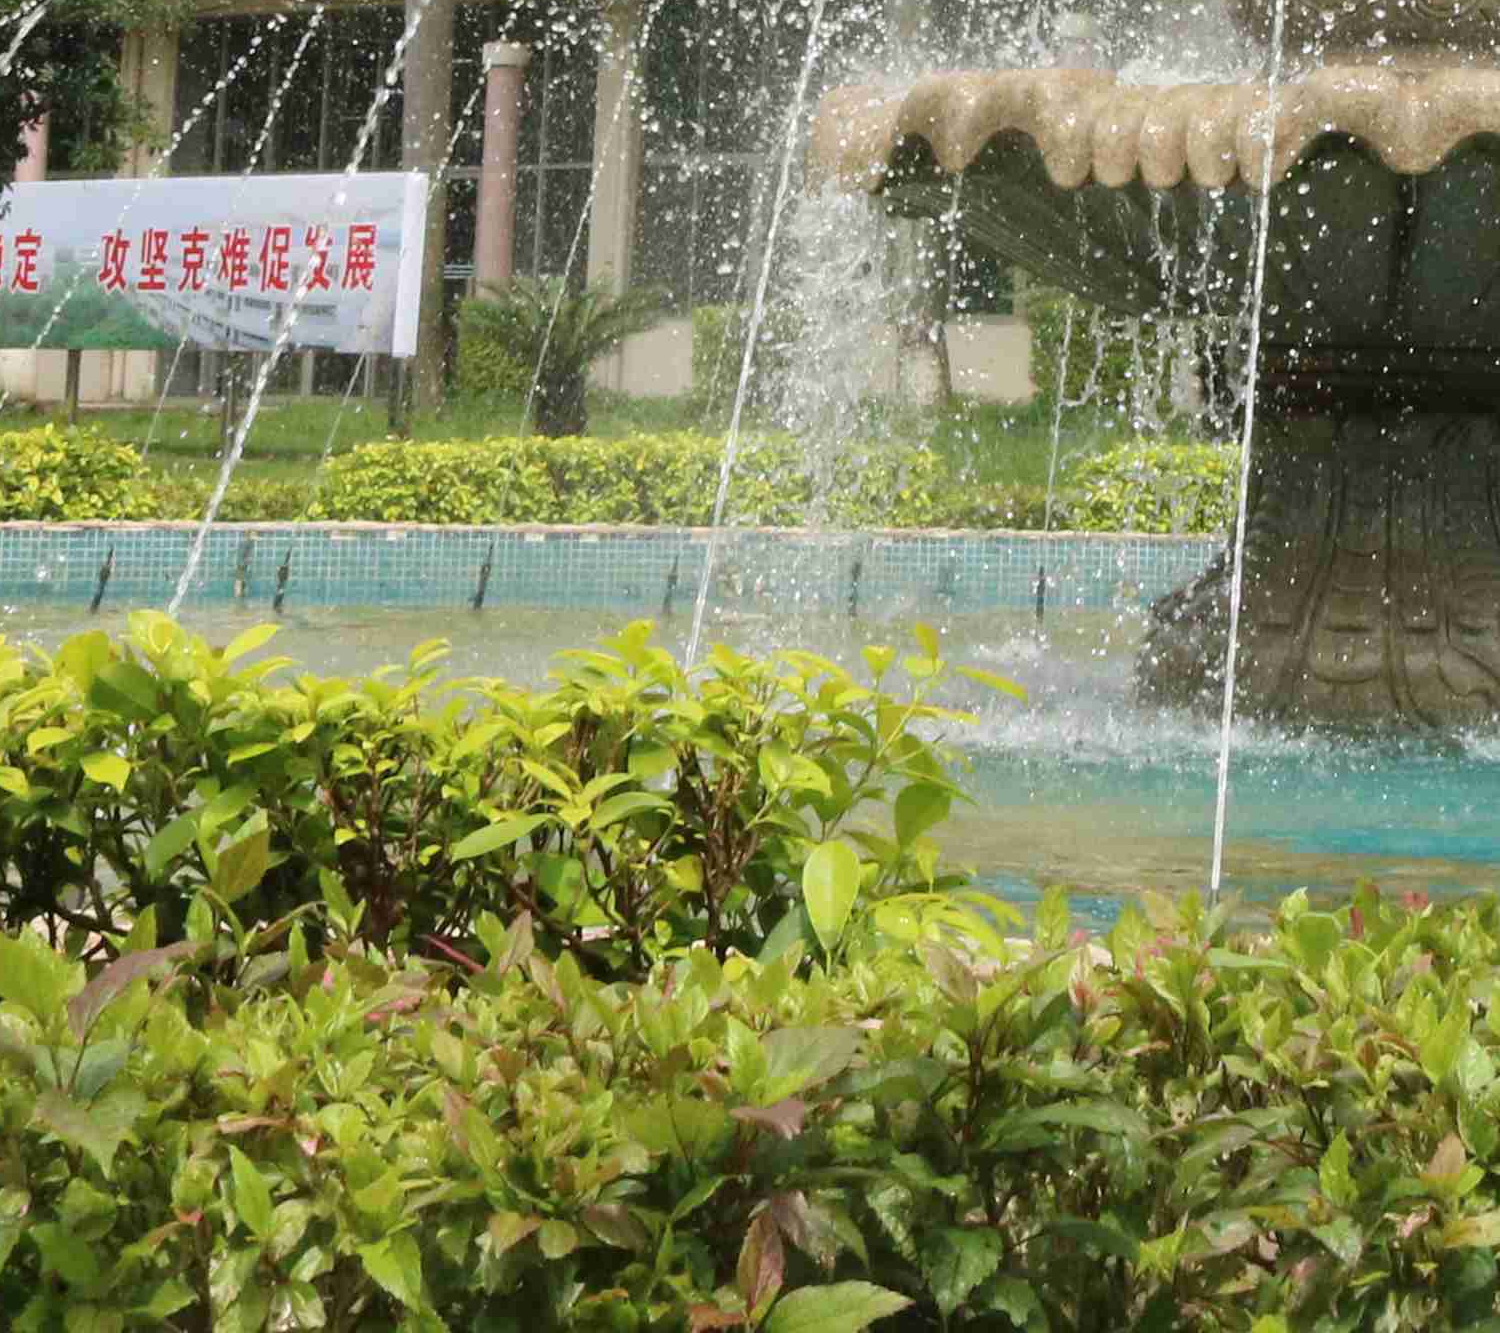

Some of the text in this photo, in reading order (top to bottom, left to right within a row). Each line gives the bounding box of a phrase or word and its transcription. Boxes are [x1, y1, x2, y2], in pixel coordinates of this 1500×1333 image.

[99, 223, 377, 291] 攻坚克难促发展
